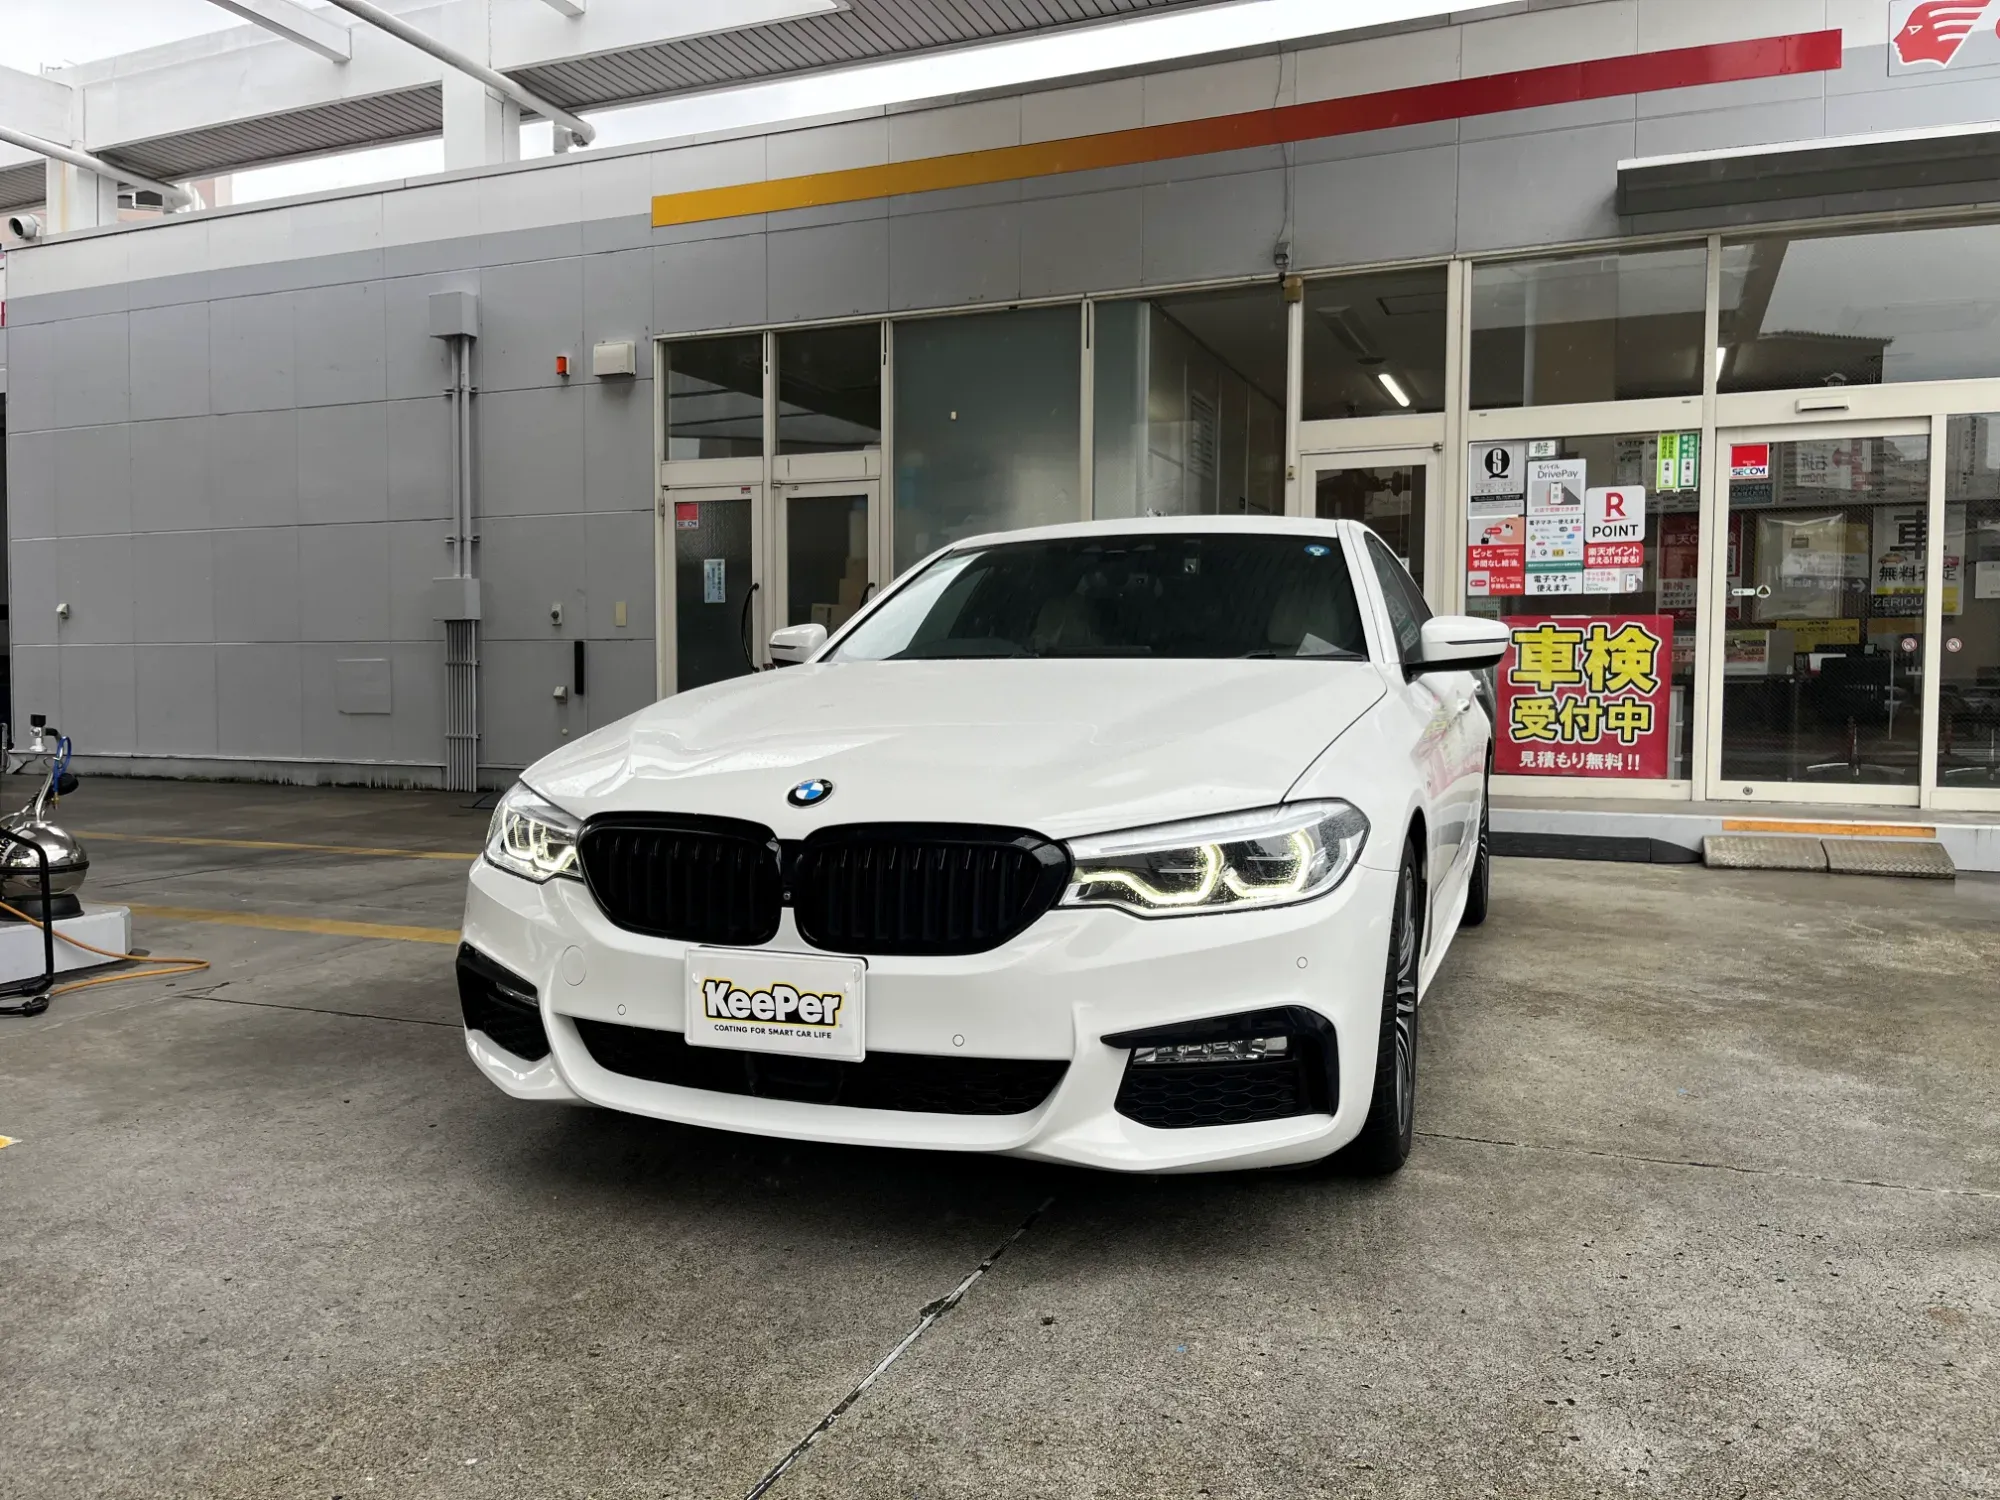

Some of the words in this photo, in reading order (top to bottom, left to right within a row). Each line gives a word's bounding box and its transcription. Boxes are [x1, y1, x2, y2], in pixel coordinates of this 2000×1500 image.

[1535, 442, 1550, 454] 軽
[1537, 469, 1578, 479] DrivePay
[1732, 467, 1766, 476] SECOM
[1605, 492, 1626, 517] R
[1592, 524, 1638, 538] POINT
[1472, 549, 1493, 558] ピッと
[1587, 546, 1640, 556] 楽天ポイント
[1533, 574, 1577, 583] 電子マネー
[1537, 584, 1572, 592] 使えます。
[1510, 623, 1661, 694] 車検
[1510, 695, 1654, 745] 受付中
[701, 978, 842, 1026] KeePer
[714, 1024, 748, 1033] COATING
[768, 1028, 793, 1036] SMART
[814, 1031, 832, 1039] LIFE
